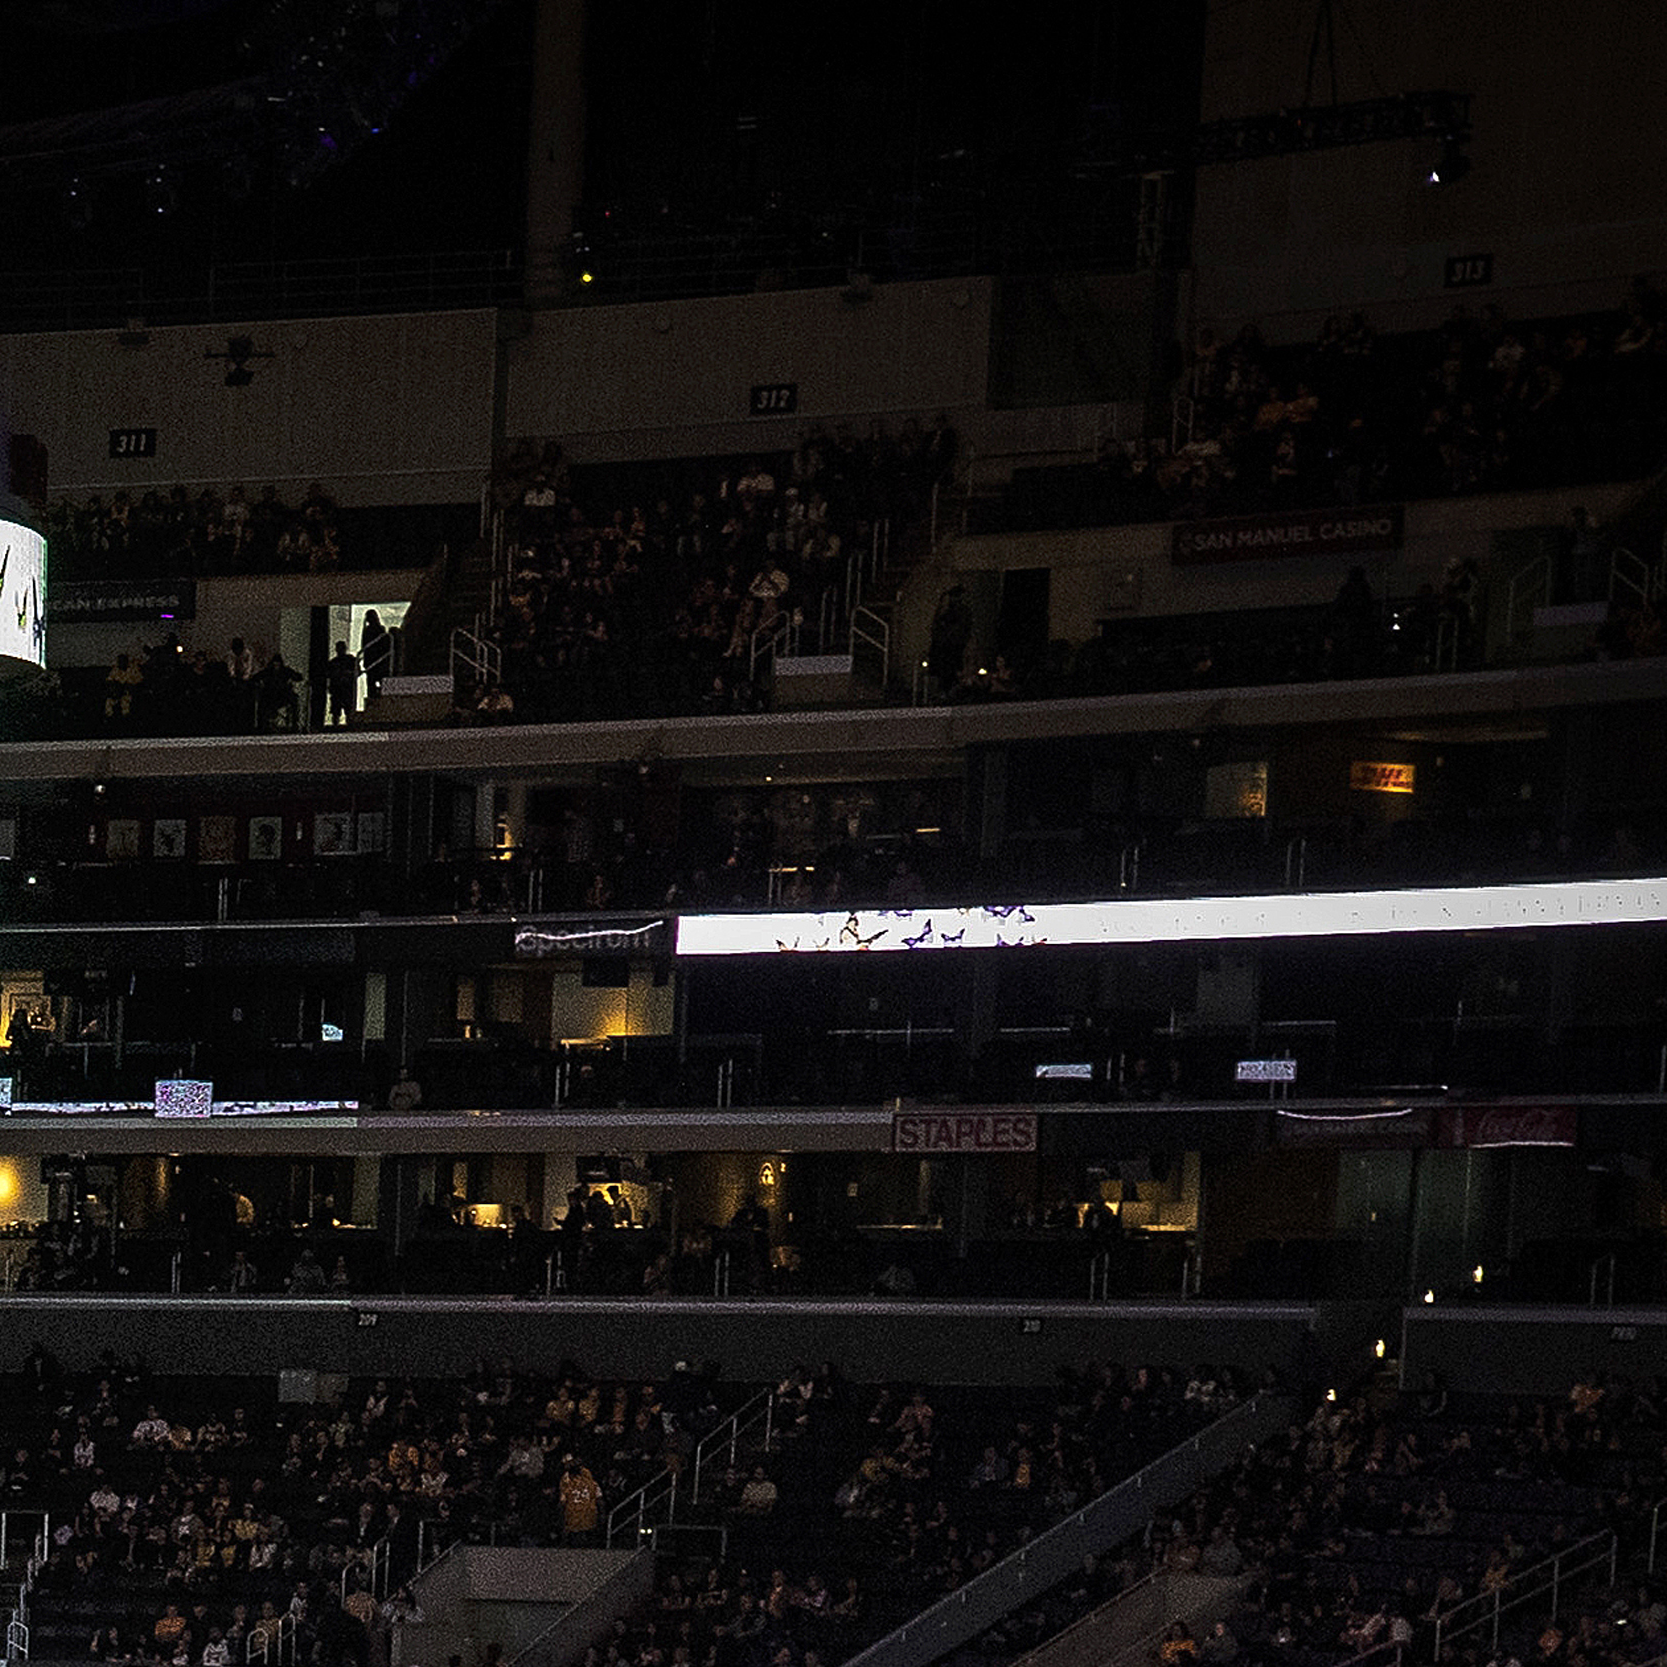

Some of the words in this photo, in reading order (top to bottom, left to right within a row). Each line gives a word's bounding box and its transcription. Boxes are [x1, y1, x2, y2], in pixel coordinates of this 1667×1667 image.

[757, 389, 790, 409] 312
[116, 433, 146, 453] 311
[1194, 531, 1233, 553] SAN
[1236, 525, 1311, 547] MANUEL
[1318, 519, 1392, 541] CASINO
[899, 1117, 1032, 1148] STAPLES
